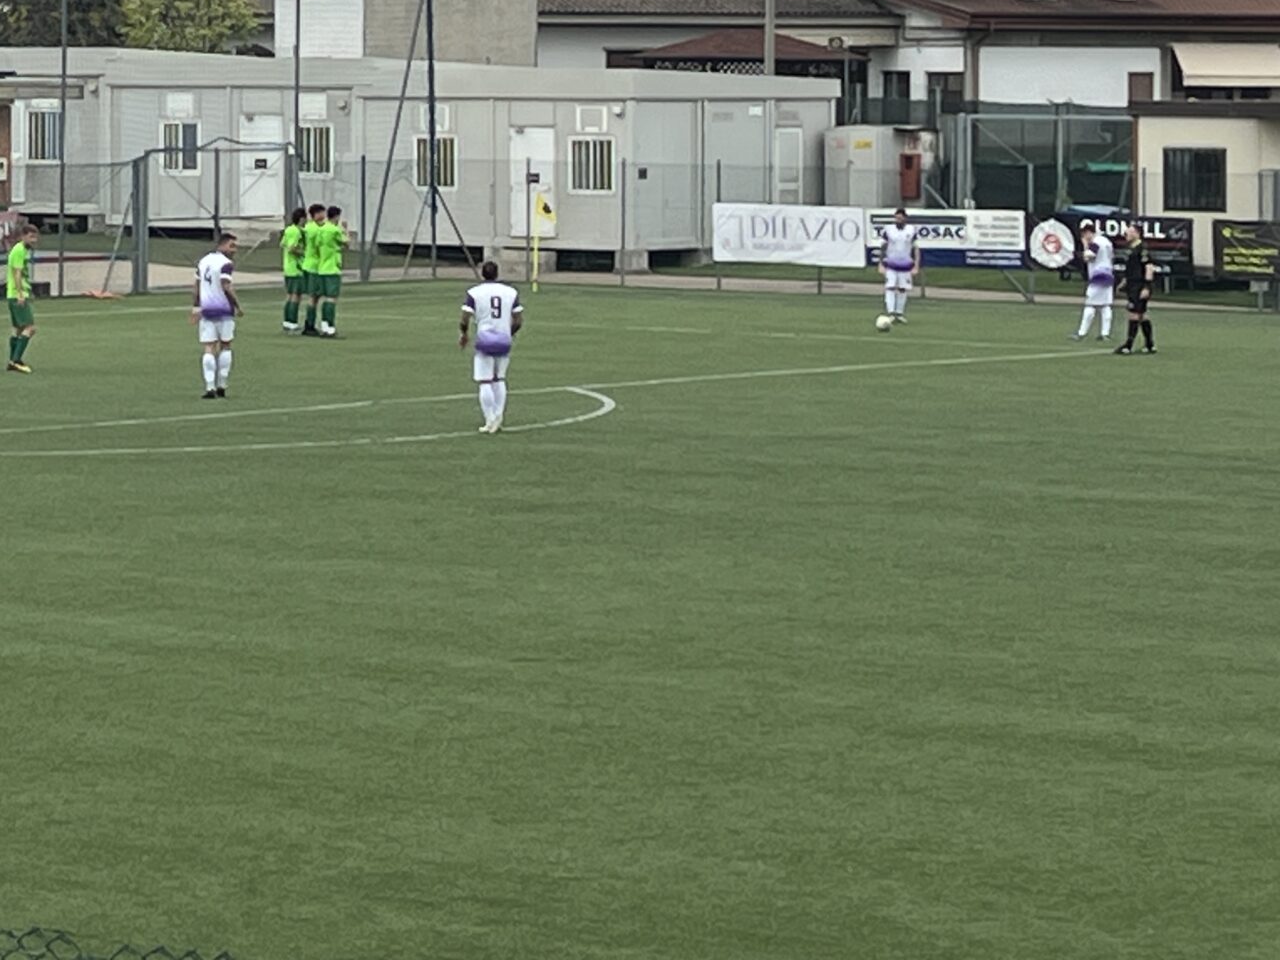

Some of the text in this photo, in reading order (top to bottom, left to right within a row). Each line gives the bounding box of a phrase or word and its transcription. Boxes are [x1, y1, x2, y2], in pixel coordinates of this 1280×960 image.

[873, 225, 966, 240] TOSAC
[203, 265, 213, 286] 4
[490, 295, 502, 319] 9
